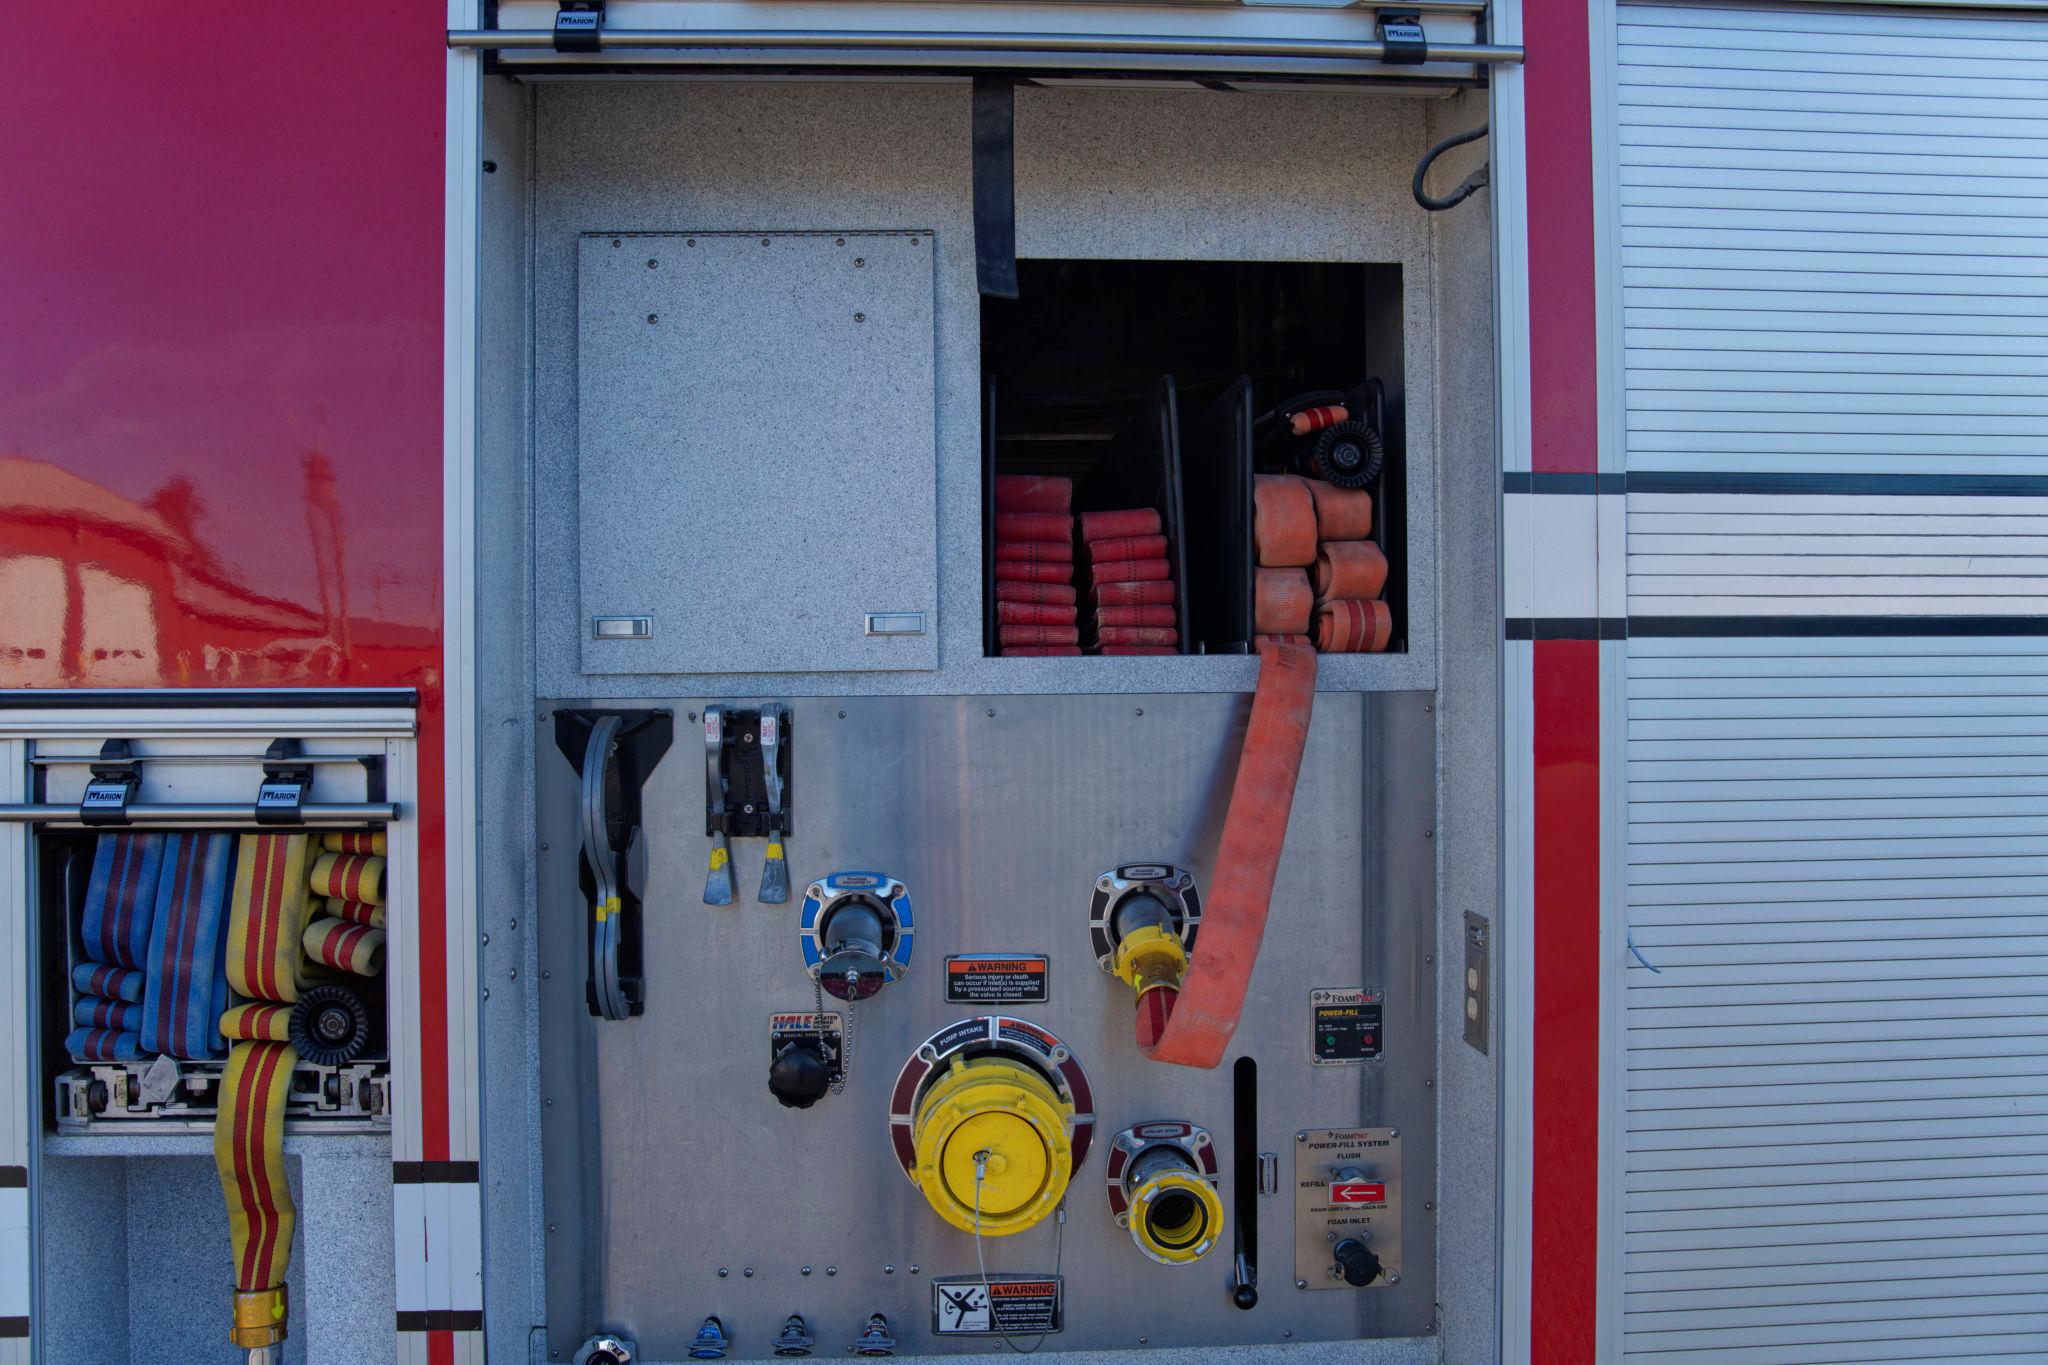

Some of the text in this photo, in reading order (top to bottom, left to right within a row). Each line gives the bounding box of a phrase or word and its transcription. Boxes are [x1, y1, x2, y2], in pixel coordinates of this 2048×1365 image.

[560, 17, 594, 25] MARION
[88, 792, 122, 800] MARION
[262, 792, 297, 800] MARION
[977, 962, 1027, 972] WARNING
[772, 1015, 813, 1029] HALE
[1015, 1022, 1046, 1039] WARNING
[939, 1025, 984, 1047] PUMP INTAKE
[1308, 1142, 1356, 1150] POWER-FILL
[1002, 1285, 1055, 1295] WARNING
